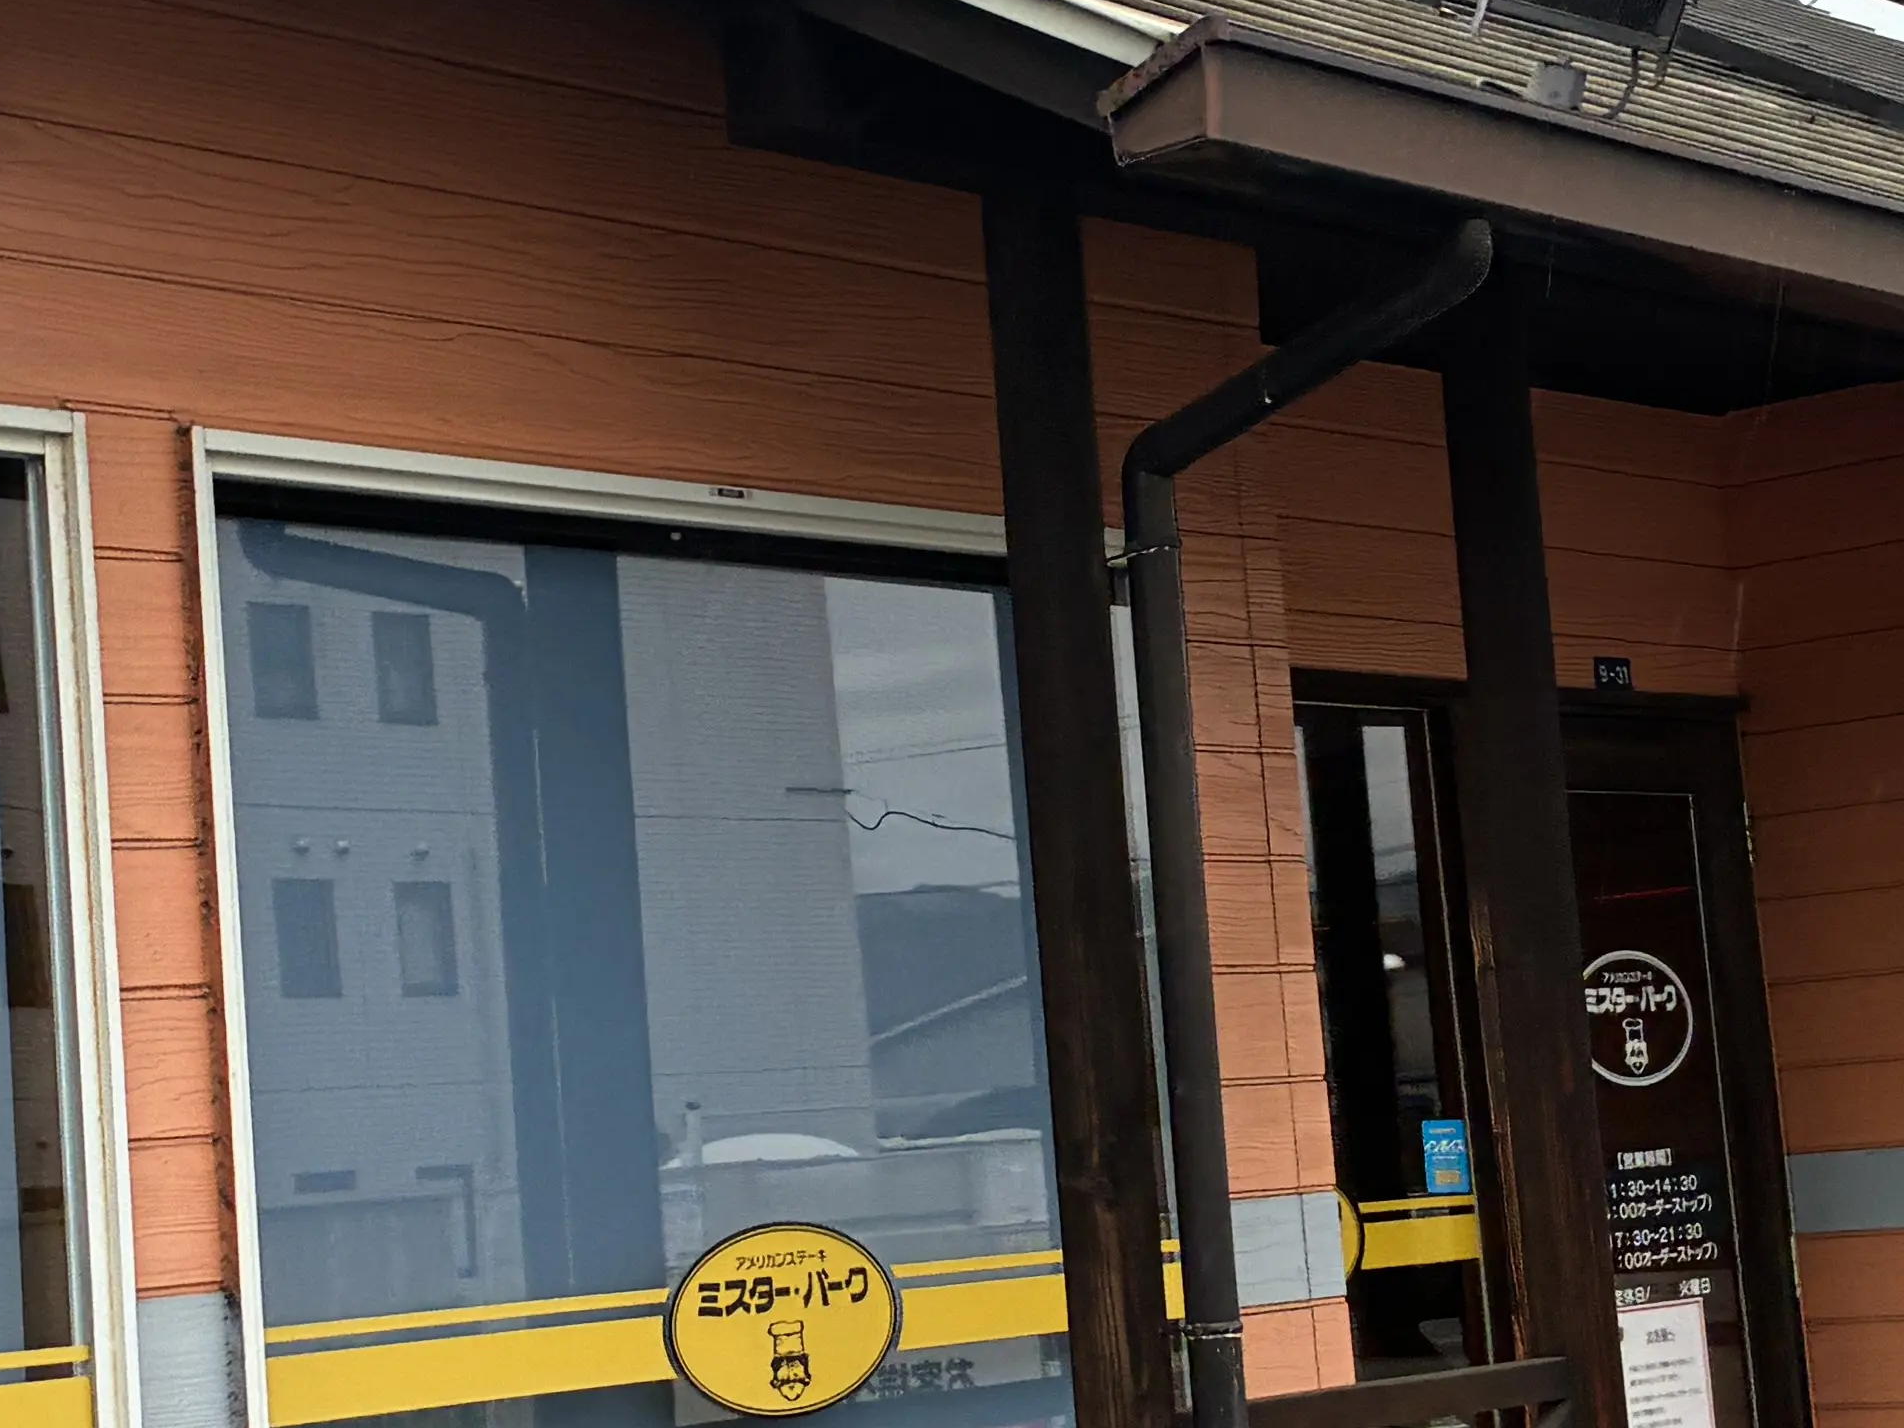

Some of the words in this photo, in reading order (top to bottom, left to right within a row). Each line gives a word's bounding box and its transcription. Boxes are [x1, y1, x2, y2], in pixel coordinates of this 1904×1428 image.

[1599, 665, 1629, 684] 9-31
[735, 1249, 828, 1270] アメリカンステーキ
